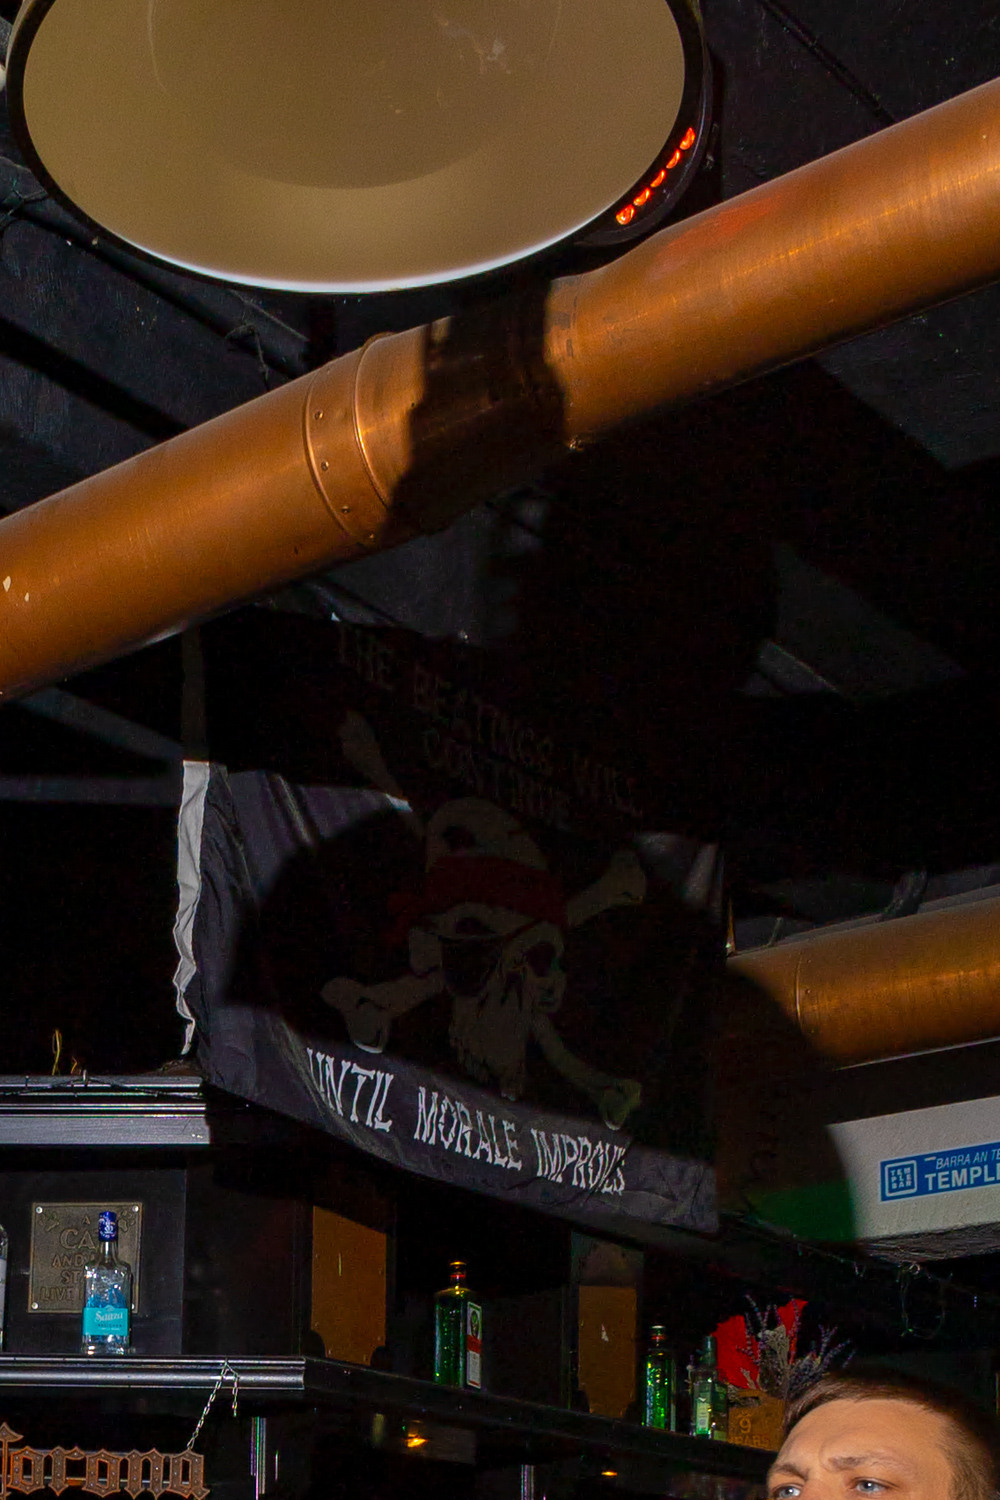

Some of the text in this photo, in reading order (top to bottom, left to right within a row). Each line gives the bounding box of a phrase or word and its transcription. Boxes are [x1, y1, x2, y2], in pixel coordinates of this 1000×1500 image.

[306, 1047, 394, 1132] UNTIL
[413, 1086, 522, 1170] MORALE
[935, 1154, 971, 1170] BARRA
[972, 1151, 988, 1163] AN
[60, 1228, 100, 1250] CA
[739, 1418, 751, 1434] 9
